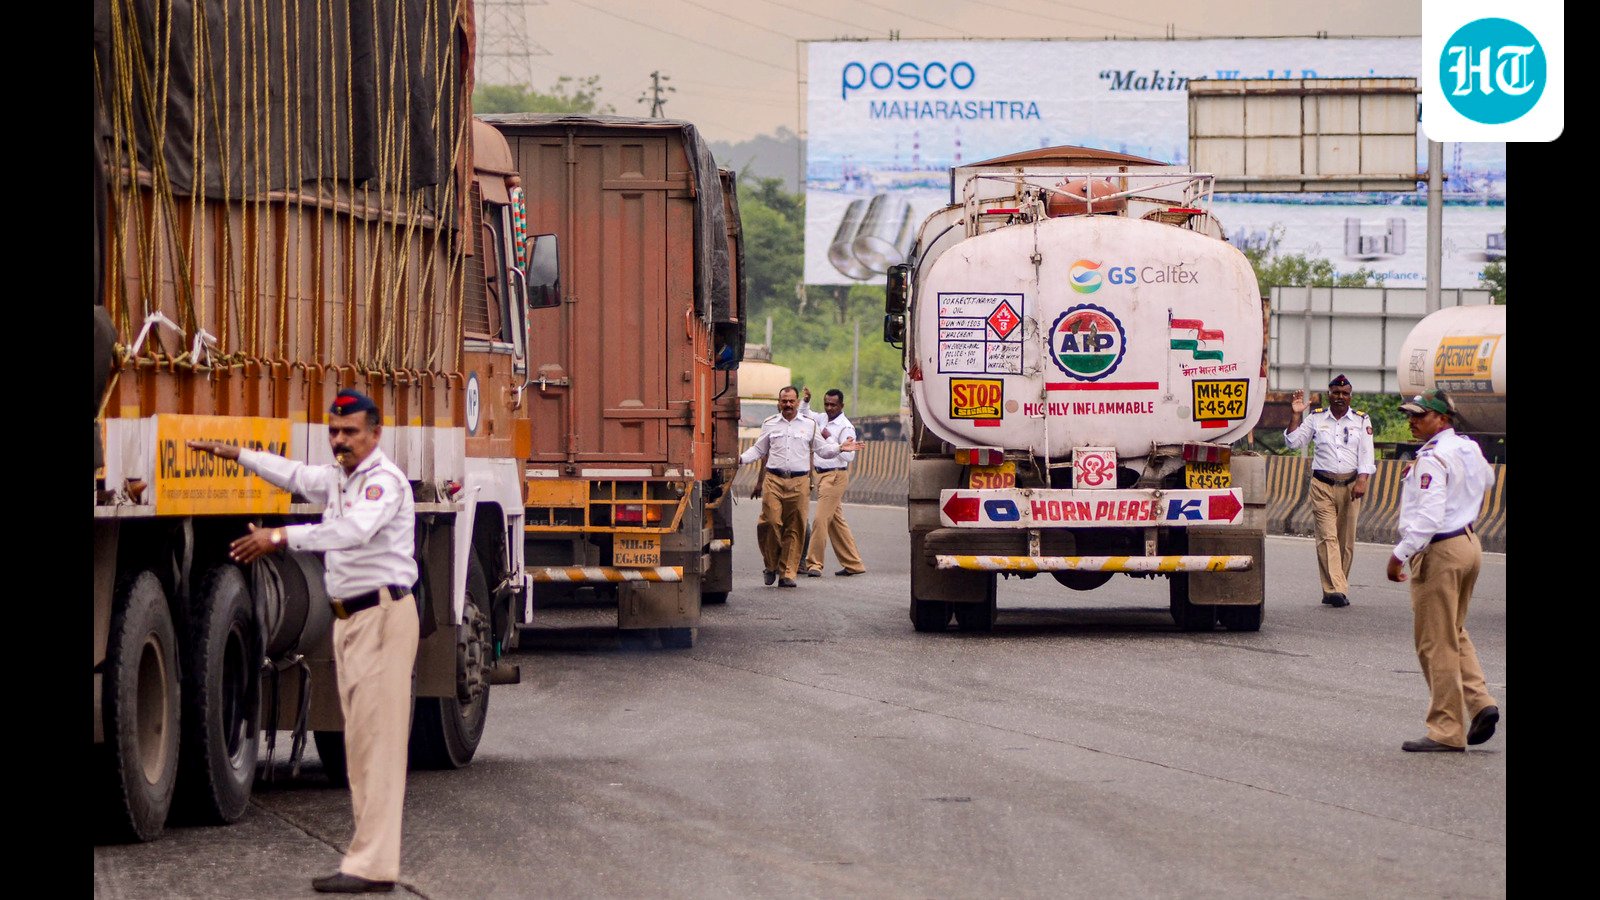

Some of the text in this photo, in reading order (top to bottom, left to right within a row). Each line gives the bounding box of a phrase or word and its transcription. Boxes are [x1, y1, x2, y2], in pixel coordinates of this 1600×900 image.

[869, 101, 1041, 120] MAHARASHTRA
[1107, 265, 1199, 285] GS Caltex
[1000, 321, 1008, 331] 3
[952, 383, 1001, 408] STOP
[1073, 401, 1154, 415] INFLAMMABLE
[159, 438, 180, 479] VRL
[970, 471, 1015, 488] STOP
[983, 499, 1021, 521] O
[1030, 499, 1091, 521] HORN
[1165, 499, 1204, 521] K
